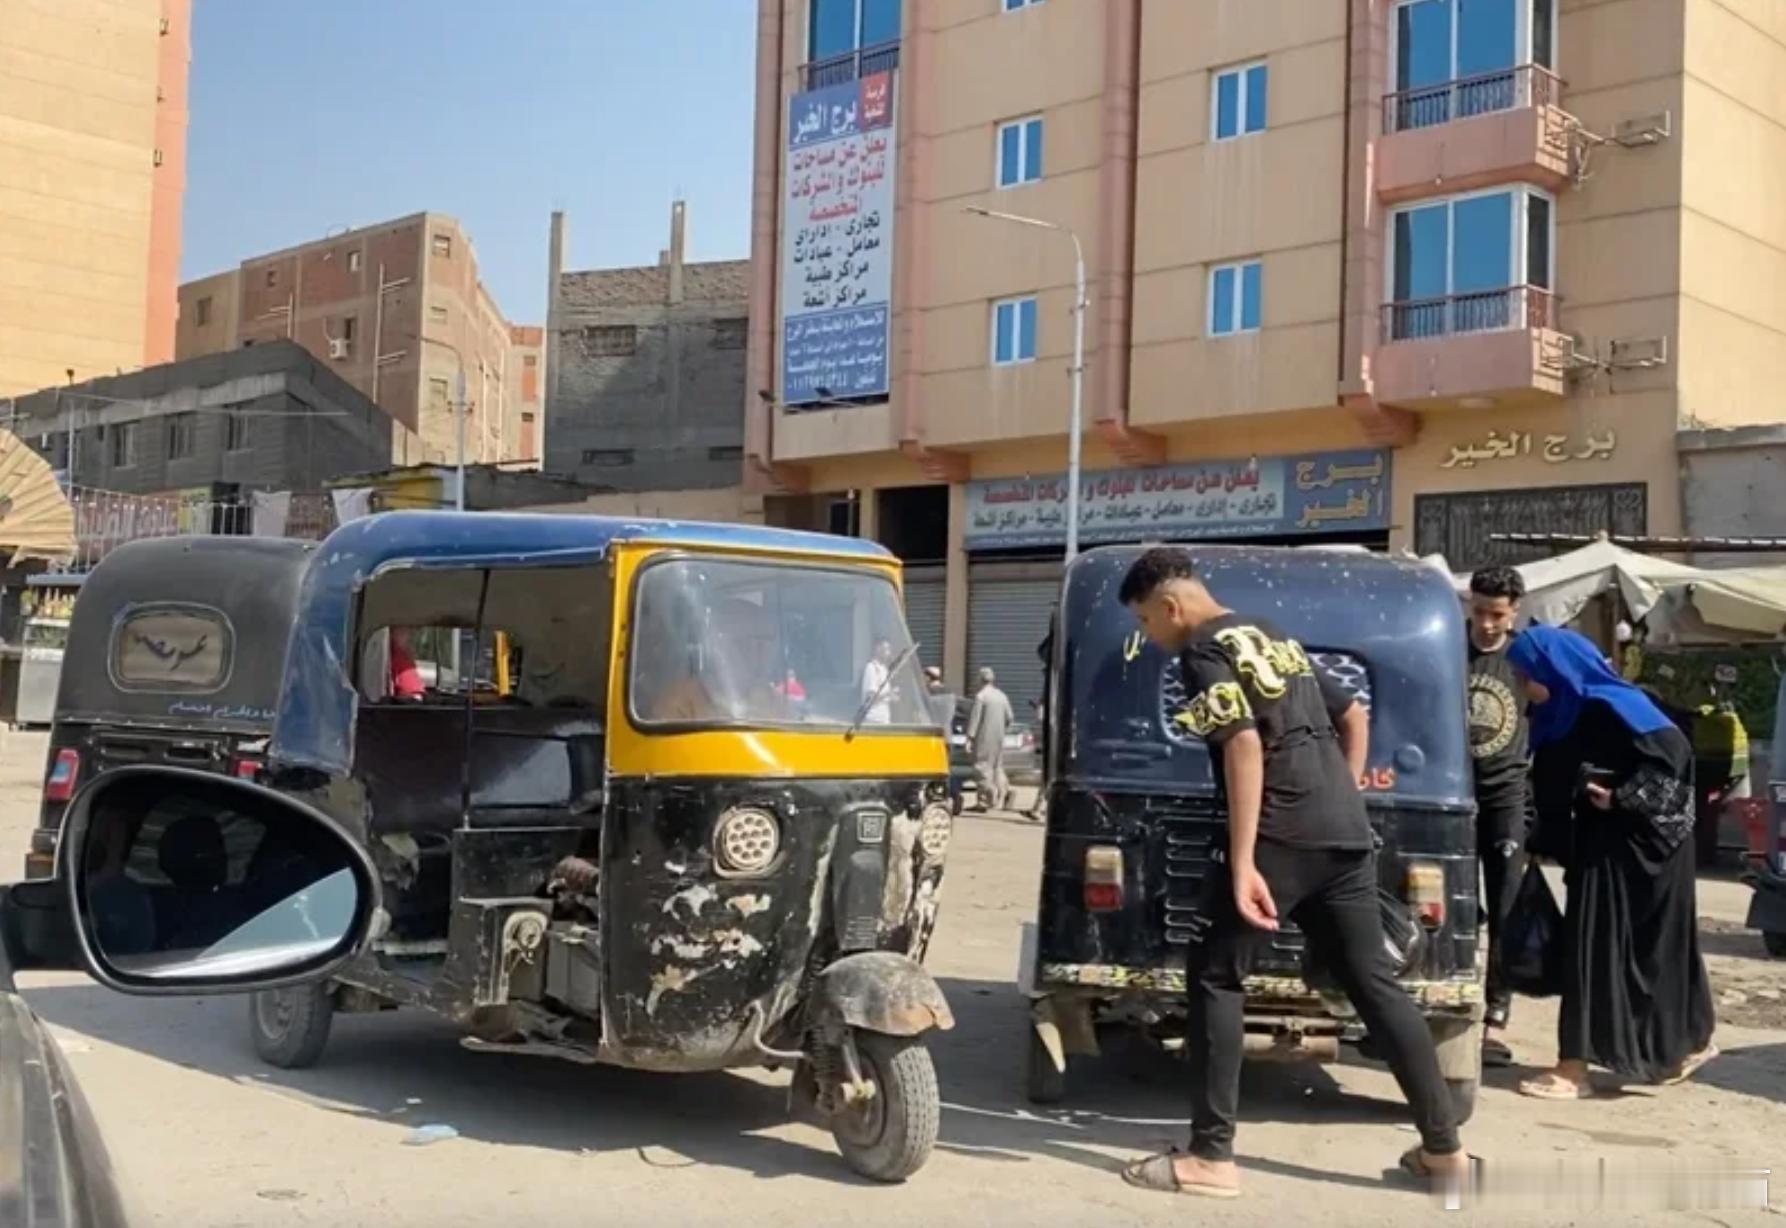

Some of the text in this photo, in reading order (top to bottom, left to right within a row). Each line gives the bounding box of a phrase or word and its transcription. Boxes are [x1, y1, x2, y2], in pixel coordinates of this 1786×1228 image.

[792, 102, 829, 144] الخير
[830, 100, 857, 135] برج
[847, 235, 880, 257] معامل
[835, 259, 869, 282] مراكز
[833, 284, 866, 308] مراكز
[1441, 426, 1617, 468] برج الخير
[1296, 454, 1383, 489] برج
[1295, 488, 1383, 528] الخير
